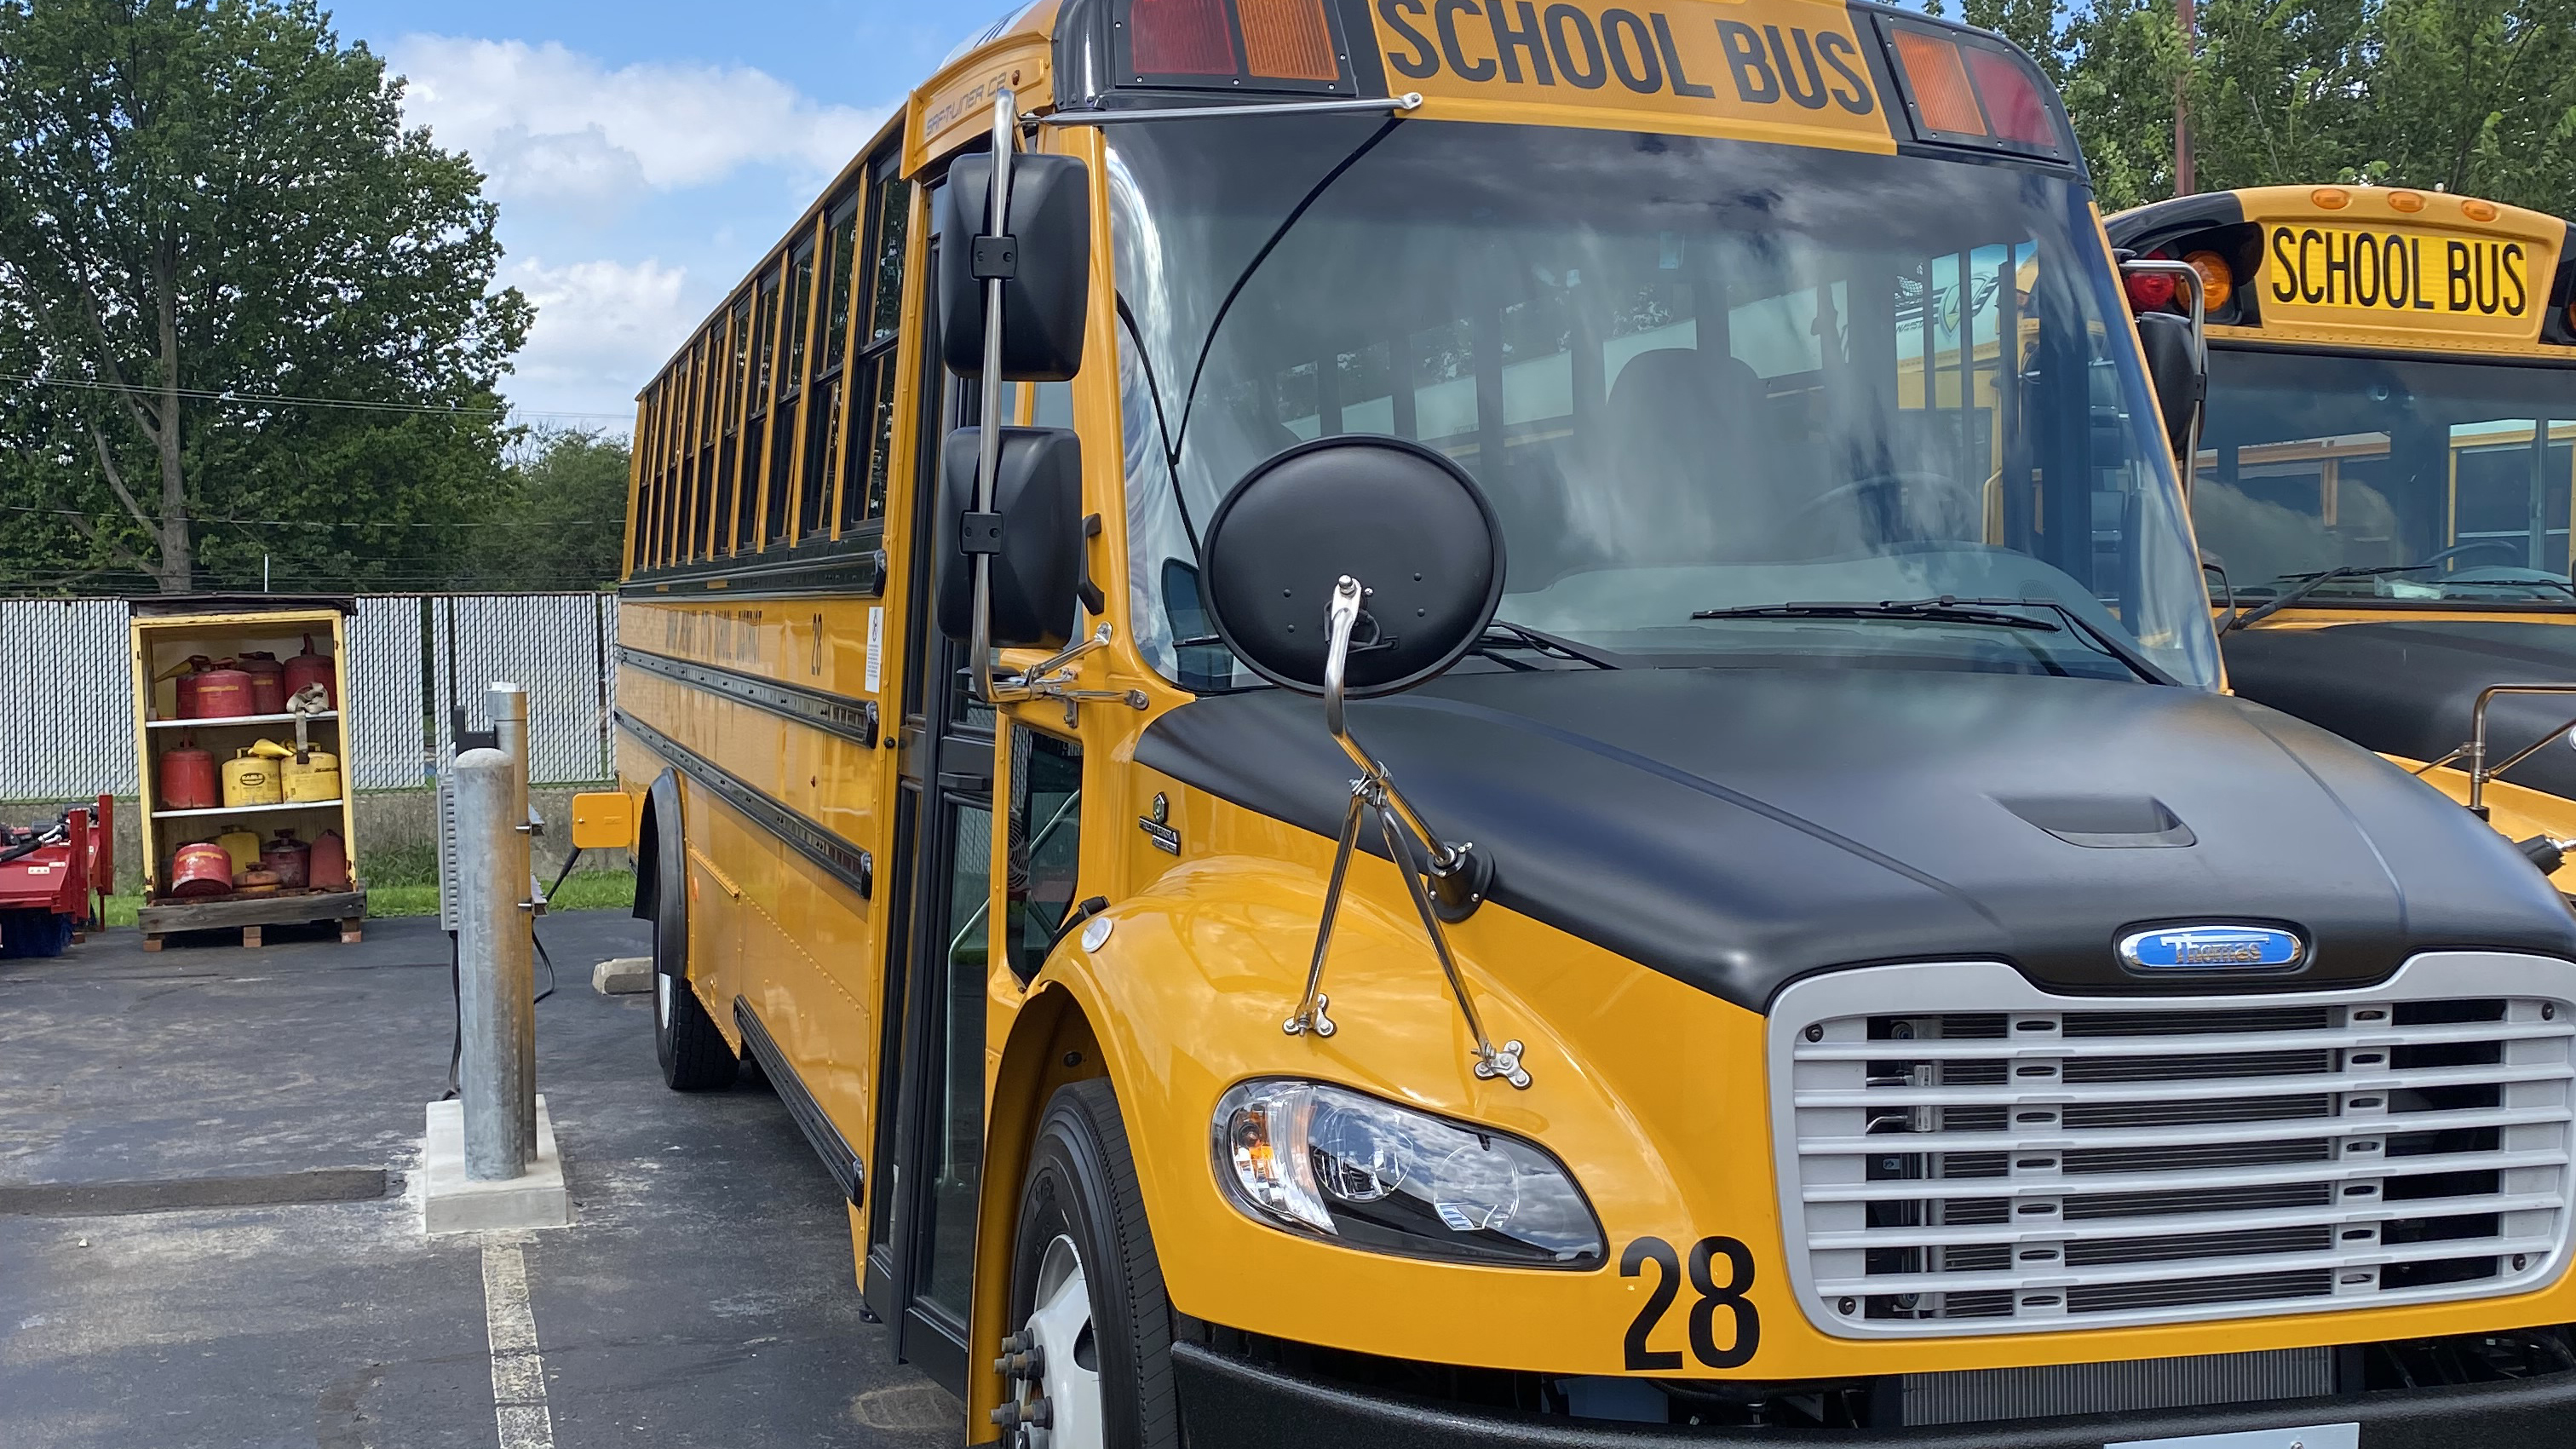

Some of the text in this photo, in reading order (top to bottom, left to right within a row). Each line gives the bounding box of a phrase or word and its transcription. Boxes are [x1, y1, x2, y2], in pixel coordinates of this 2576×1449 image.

[1378, 0, 1874, 115] SCHOOL BUS
[2273, 227, 2526, 316] SCHOOL BUS
[2160, 934, 2269, 963] Thomas
[1619, 1236, 1761, 1371] 28
